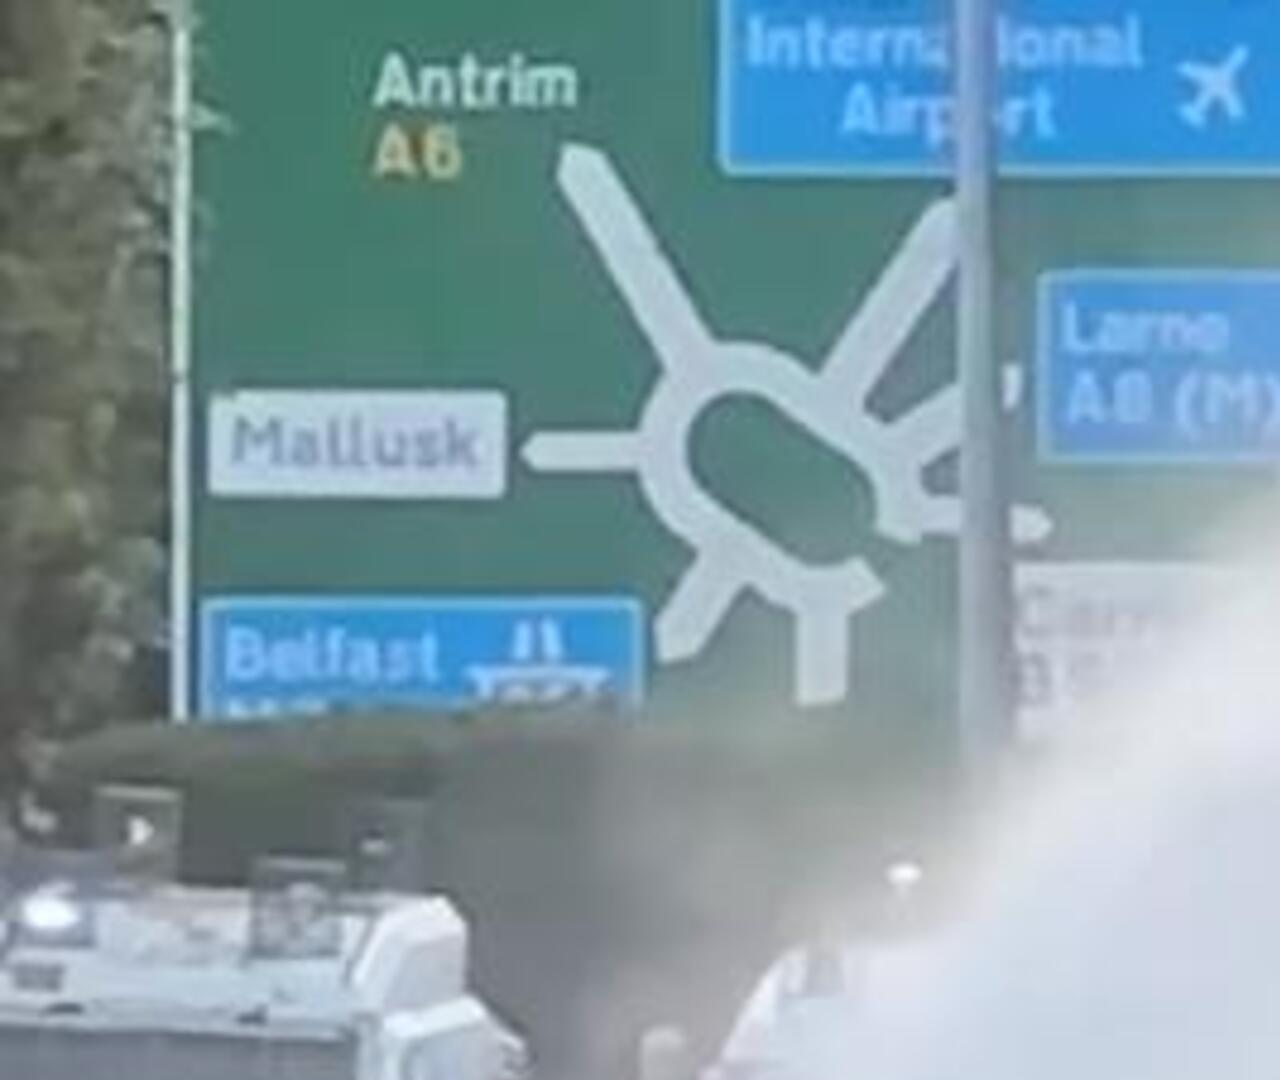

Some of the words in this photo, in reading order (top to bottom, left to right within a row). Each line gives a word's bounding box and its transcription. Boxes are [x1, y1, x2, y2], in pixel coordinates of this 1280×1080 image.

[746, 13, 1143, 69] Internaional
[374, 50, 577, 107] Antrim
[841, 81, 1057, 148] Airprt
[374, 123, 462, 180] A6
[1062, 300, 1230, 352] Larne
[231, 415, 478, 467] Mallusk
[225, 624, 440, 683] Belfast
